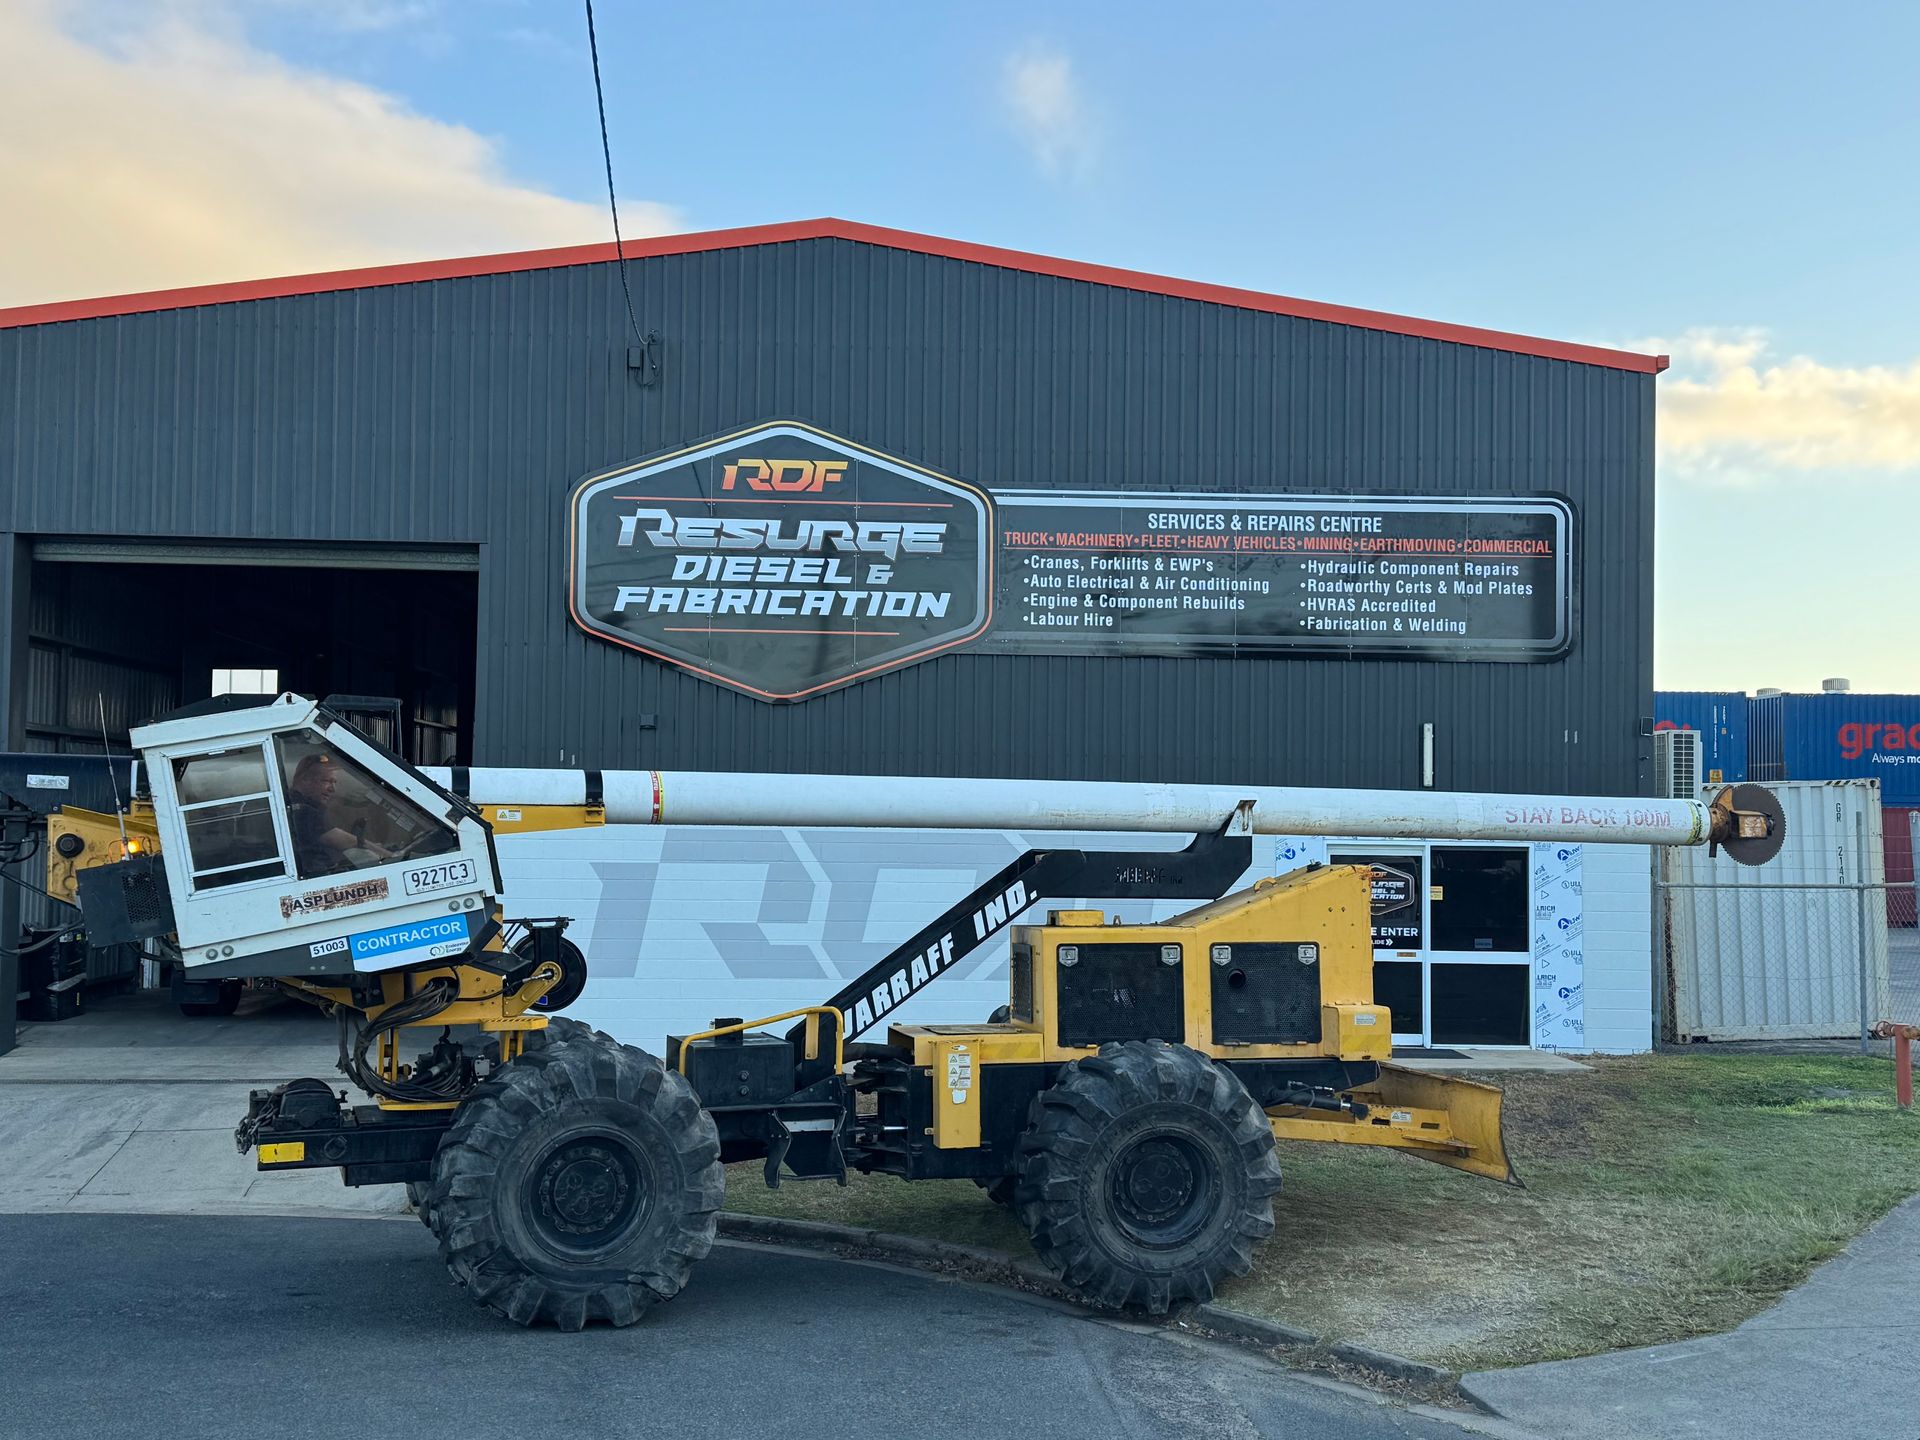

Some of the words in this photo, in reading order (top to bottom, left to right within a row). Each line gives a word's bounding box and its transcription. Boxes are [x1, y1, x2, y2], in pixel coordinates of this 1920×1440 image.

[722, 458, 848, 492] RDF
[1148, 513, 1225, 530] SERVICES
[1230, 514, 1242, 531] &
[1247, 515, 1315, 532] REPAIRS
[1320, 516, 1382, 533] CENTRE
[617, 508, 947, 561] RESURGE
[1004, 532, 1048, 546] TRUCK
[1056, 533, 1133, 548] MACHINERY
[1141, 535, 1179, 548] FLEET
[1188, 535, 1229, 549] HEAVY
[1233, 536, 1296, 551] VEHICLES
[1304, 537, 1351, 550] MINING
[1360, 538, 1456, 552] EARTHMOVING
[1464, 539, 1552, 553] COMMERCIAL
[671, 555, 852, 583] DIESEL
[866, 564, 893, 584] &
[1091, 556, 1149, 571] Forklifts
[1154, 558, 1164, 571] &
[1170, 558, 1213, 572] EWP's
[1380, 562, 1459, 578] Component
[1465, 562, 1519, 579] Repairs
[1067, 575, 1134, 589] Electrical
[1139, 577, 1149, 590] &
[1155, 577, 1175, 590] Air
[1180, 577, 1269, 593] Conditioning
[1396, 580, 1432, 594] Certs
[1437, 581, 1447, 594] &
[1453, 581, 1483, 595] Mod
[1489, 582, 1533, 595] Plates
[613, 586, 951, 618] FABRICATION
[1083, 595, 1094, 608] &
[1099, 594, 1178, 612] Component
[1183, 596, 1245, 610] Rebuilds
[1361, 599, 1436, 613] Accredited
[1084, 613, 1113, 626] Hire
[1393, 618, 1403, 631] &
[1408, 618, 1466, 634] Welding
[1872, 753, 1905, 766] Always
[1505, 807, 1553, 824] STAY
[1561, 807, 1617, 825] BACK
[411, 863, 469, 888] 9227C3
[292, 884, 379, 911] ASPLUNDH
[357, 922, 462, 952] CONTRACTOR
[1381, 927, 1418, 937] ENTER
[313, 940, 345, 955] 51003
[843, 932, 954, 1039] JARRAFF
[973, 880, 1038, 941] IND.
